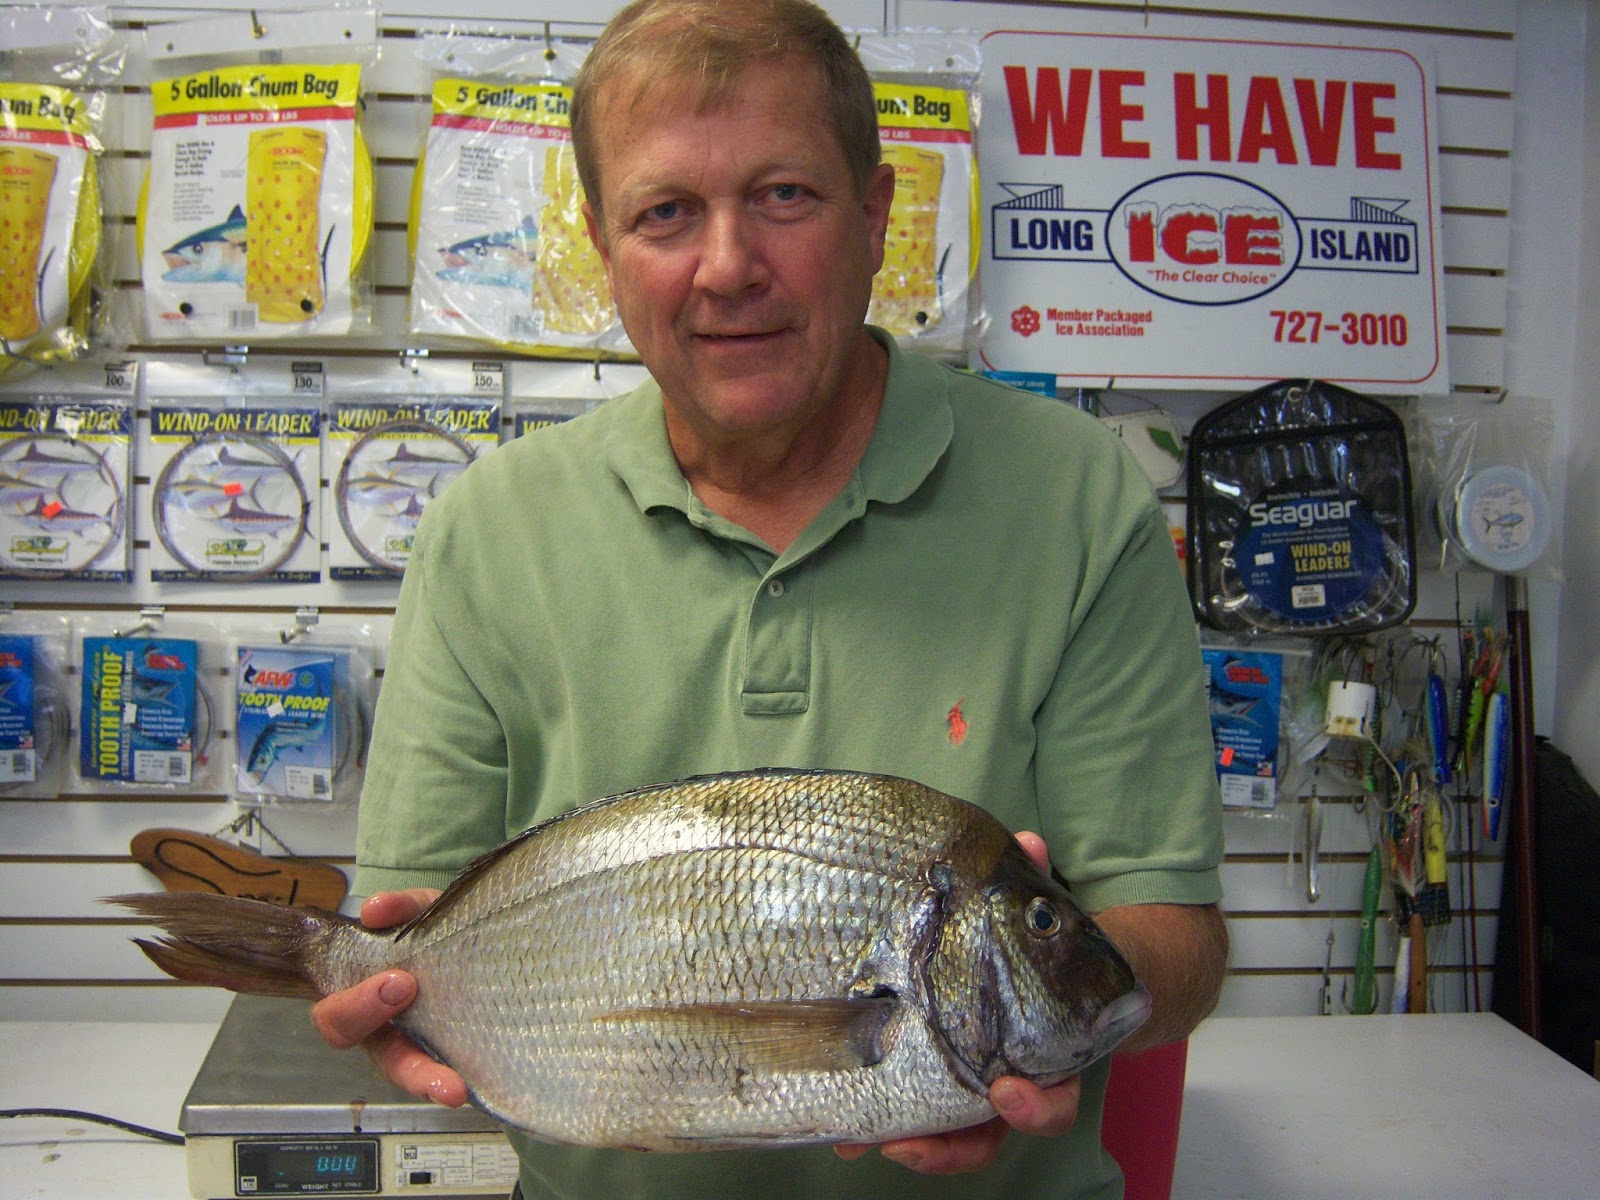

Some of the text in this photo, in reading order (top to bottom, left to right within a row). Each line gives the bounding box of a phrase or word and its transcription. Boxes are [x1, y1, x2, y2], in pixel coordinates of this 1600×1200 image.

[171, 73, 339, 100] 5 Gallon Chum Bag
[0, 98, 33, 116] um
[456, 86, 569, 114] 5 Gallon Ch
[877, 95, 951, 123] um Bag
[205, 113, 231, 123] OLDS
[251, 112, 264, 122] TO
[1003, 65, 1402, 170] WE HAVE
[1011, 202, 1411, 266] LONG ICE ISLAND
[1147, 269, 1276, 284] "The Clear Choice"
[1047, 308, 1152, 324] Member Packaged
[1056, 323, 1144, 337] Ice Association
[1270, 310, 1408, 347] 727-3010
[0, 408, 51, 431] ND-ON
[158, 411, 313, 434] WIND-ON LEADER
[337, 408, 492, 430] WIND-ON LEADER
[1249, 500, 1358, 528] Seaguar
[1291, 540, 1351, 559] WIND-ON
[1295, 556, 1350, 573] LEADERS
[254, 671, 295, 688] AFW
[99, 650, 122, 775] TOOTH PROOF
[284, 695, 330, 711] PROOF
